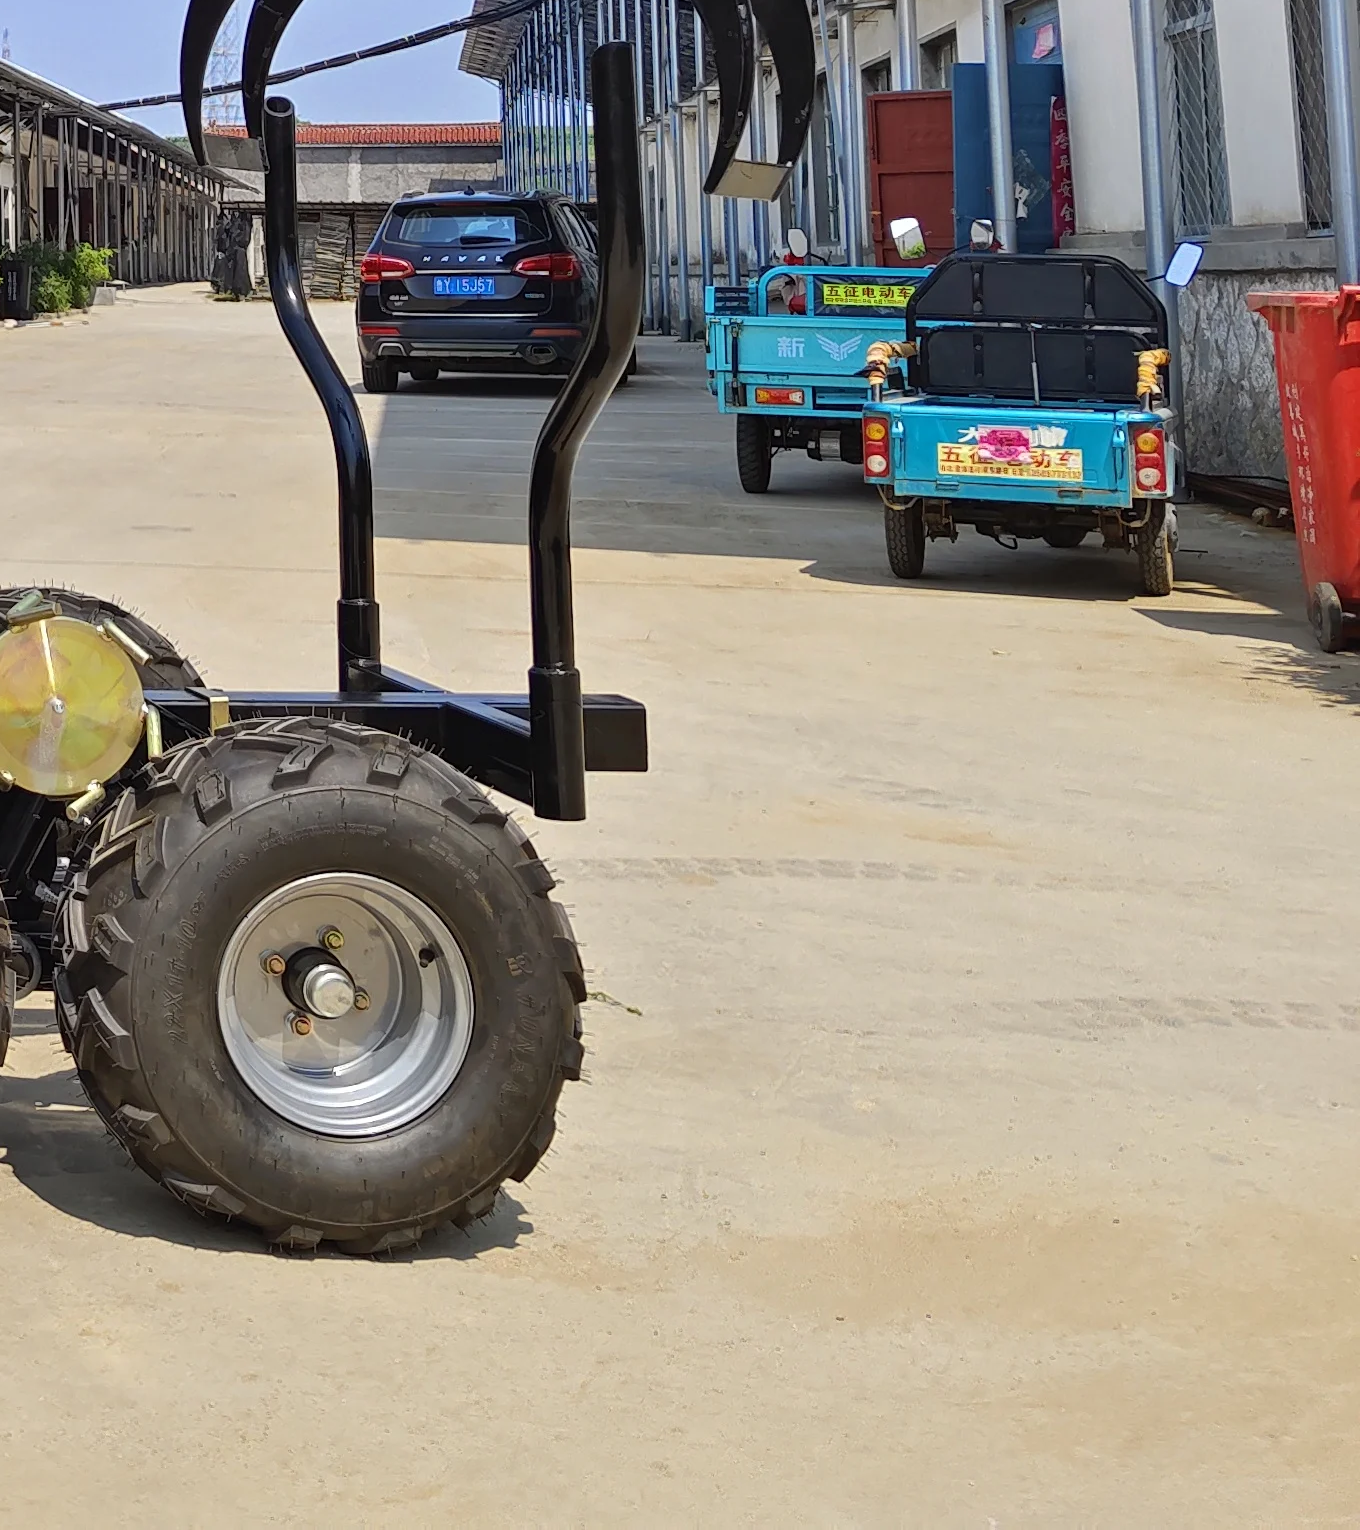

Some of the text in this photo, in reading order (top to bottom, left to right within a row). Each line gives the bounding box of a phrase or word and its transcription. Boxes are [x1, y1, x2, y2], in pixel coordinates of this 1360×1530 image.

[422, 255, 504, 263] HAVAL
[826, 285, 912, 300] 五征电动车
[940, 445, 1077, 469] 五征动车
